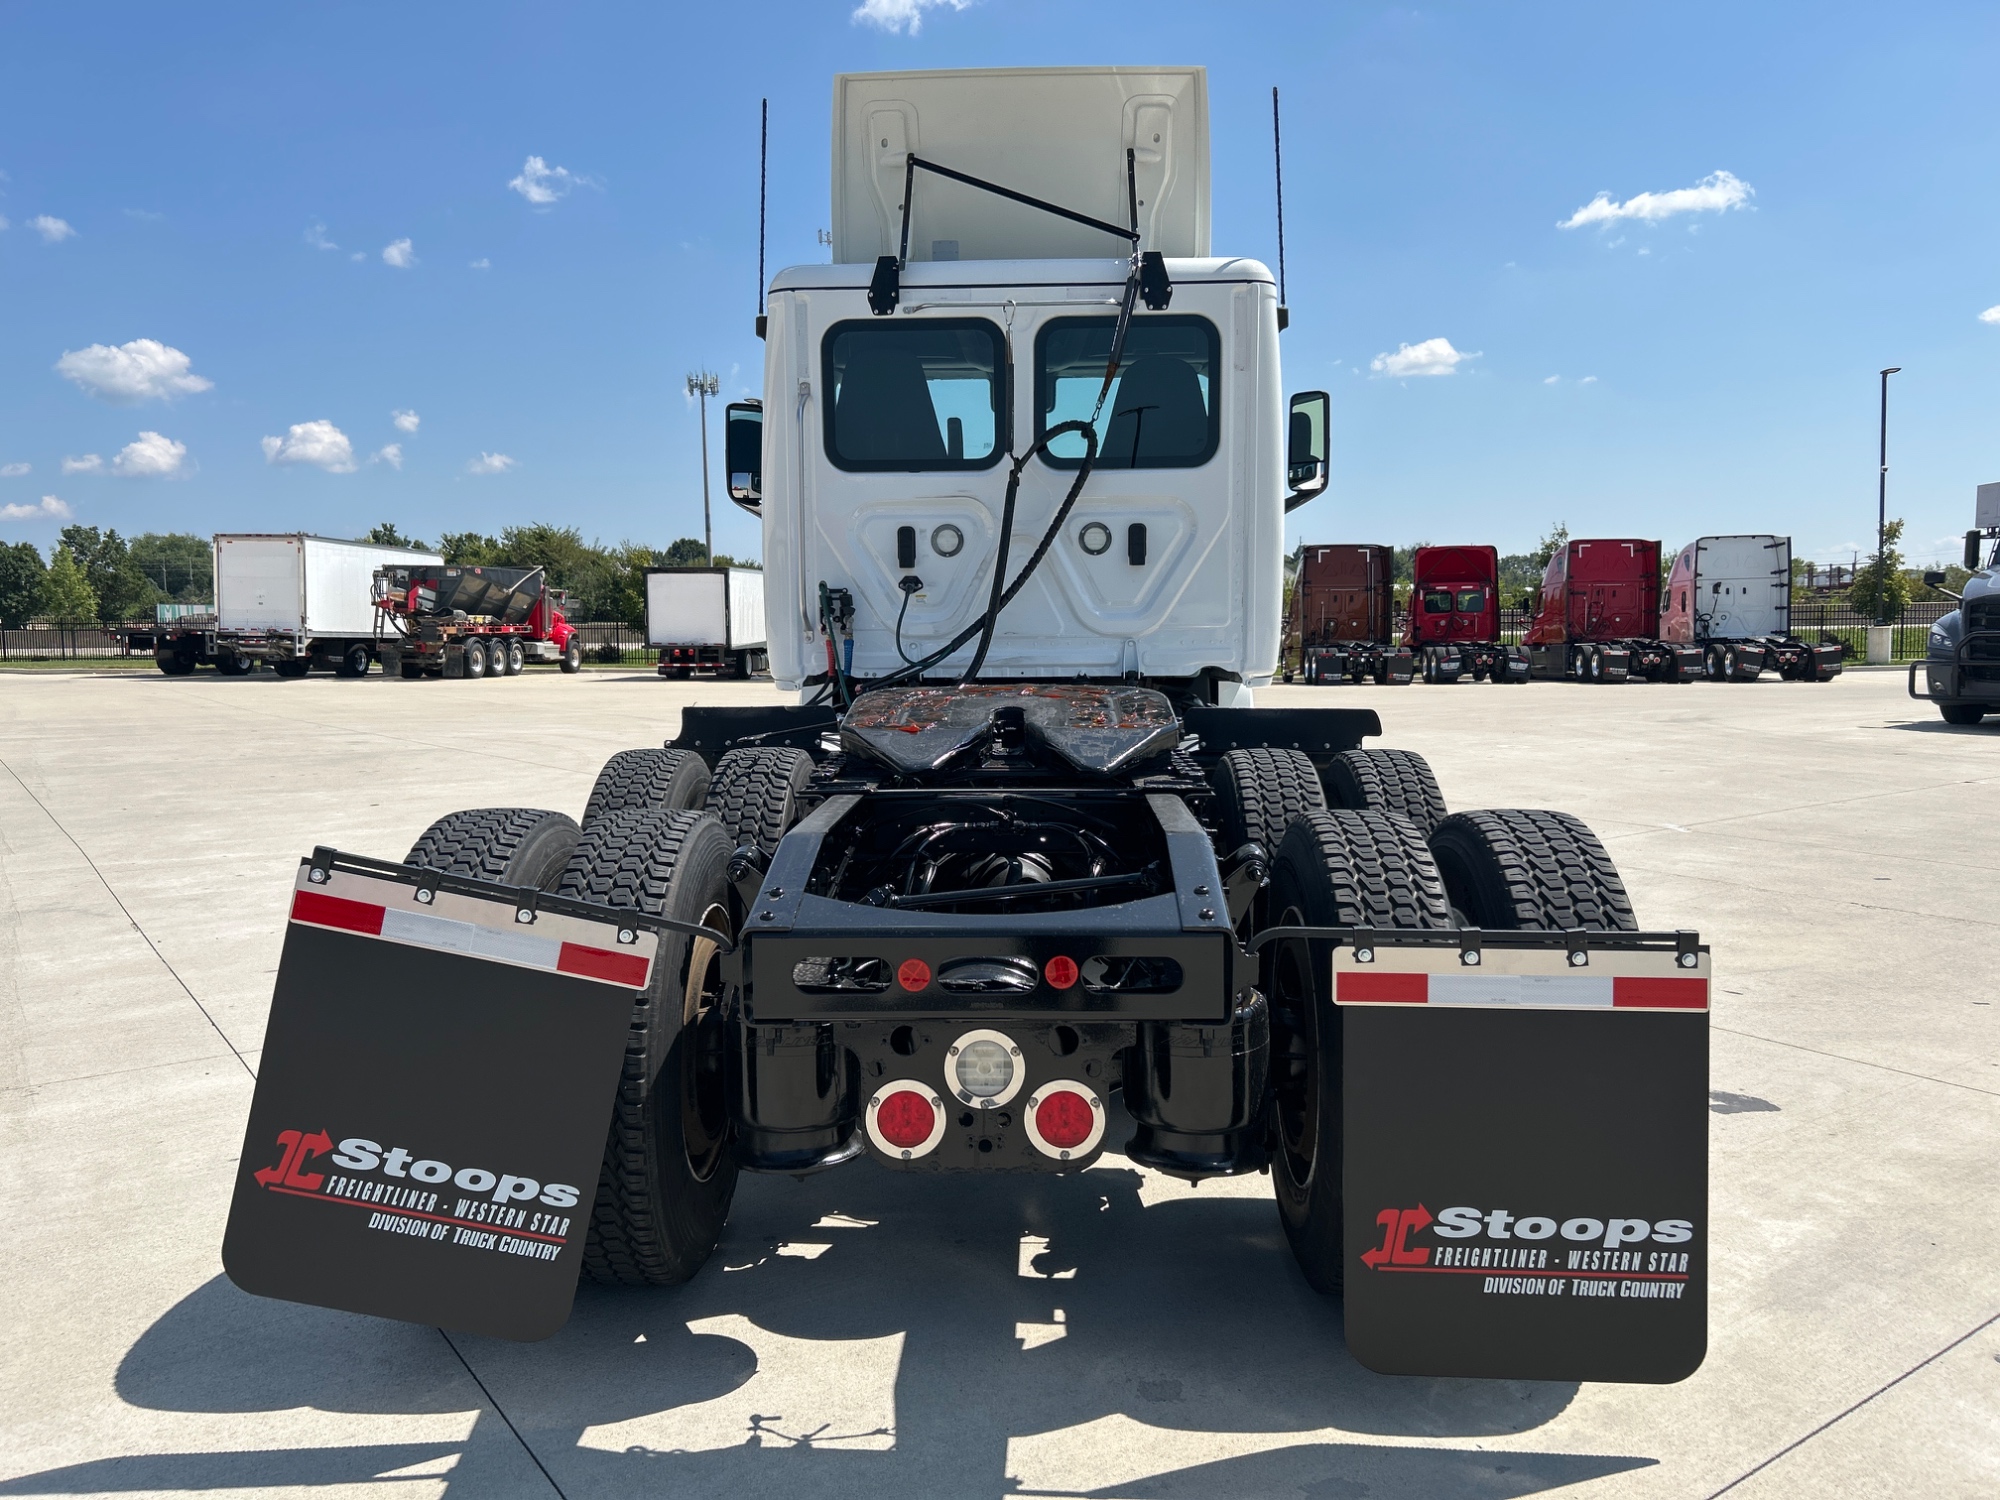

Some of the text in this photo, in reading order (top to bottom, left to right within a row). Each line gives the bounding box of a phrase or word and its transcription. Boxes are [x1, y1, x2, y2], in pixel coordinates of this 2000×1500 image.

[331, 1137, 580, 1208] Stoops
[325, 1175, 438, 1210] FREIGHTLINER
[454, 1198, 526, 1229] WESTERN
[530, 1217, 571, 1237] STAR
[1433, 1206, 1694, 1249] Stoops
[368, 1212, 562, 1261] DIVISION OF TRUCK COUNTRY
[1434, 1247, 1548, 1270] FREIGHTLINER
[1567, 1250, 1642, 1272] WESTERN
[1648, 1252, 1689, 1273] STAR
[1483, 1277, 1686, 1300] DIVISION OF TRUCK COUNTRY
